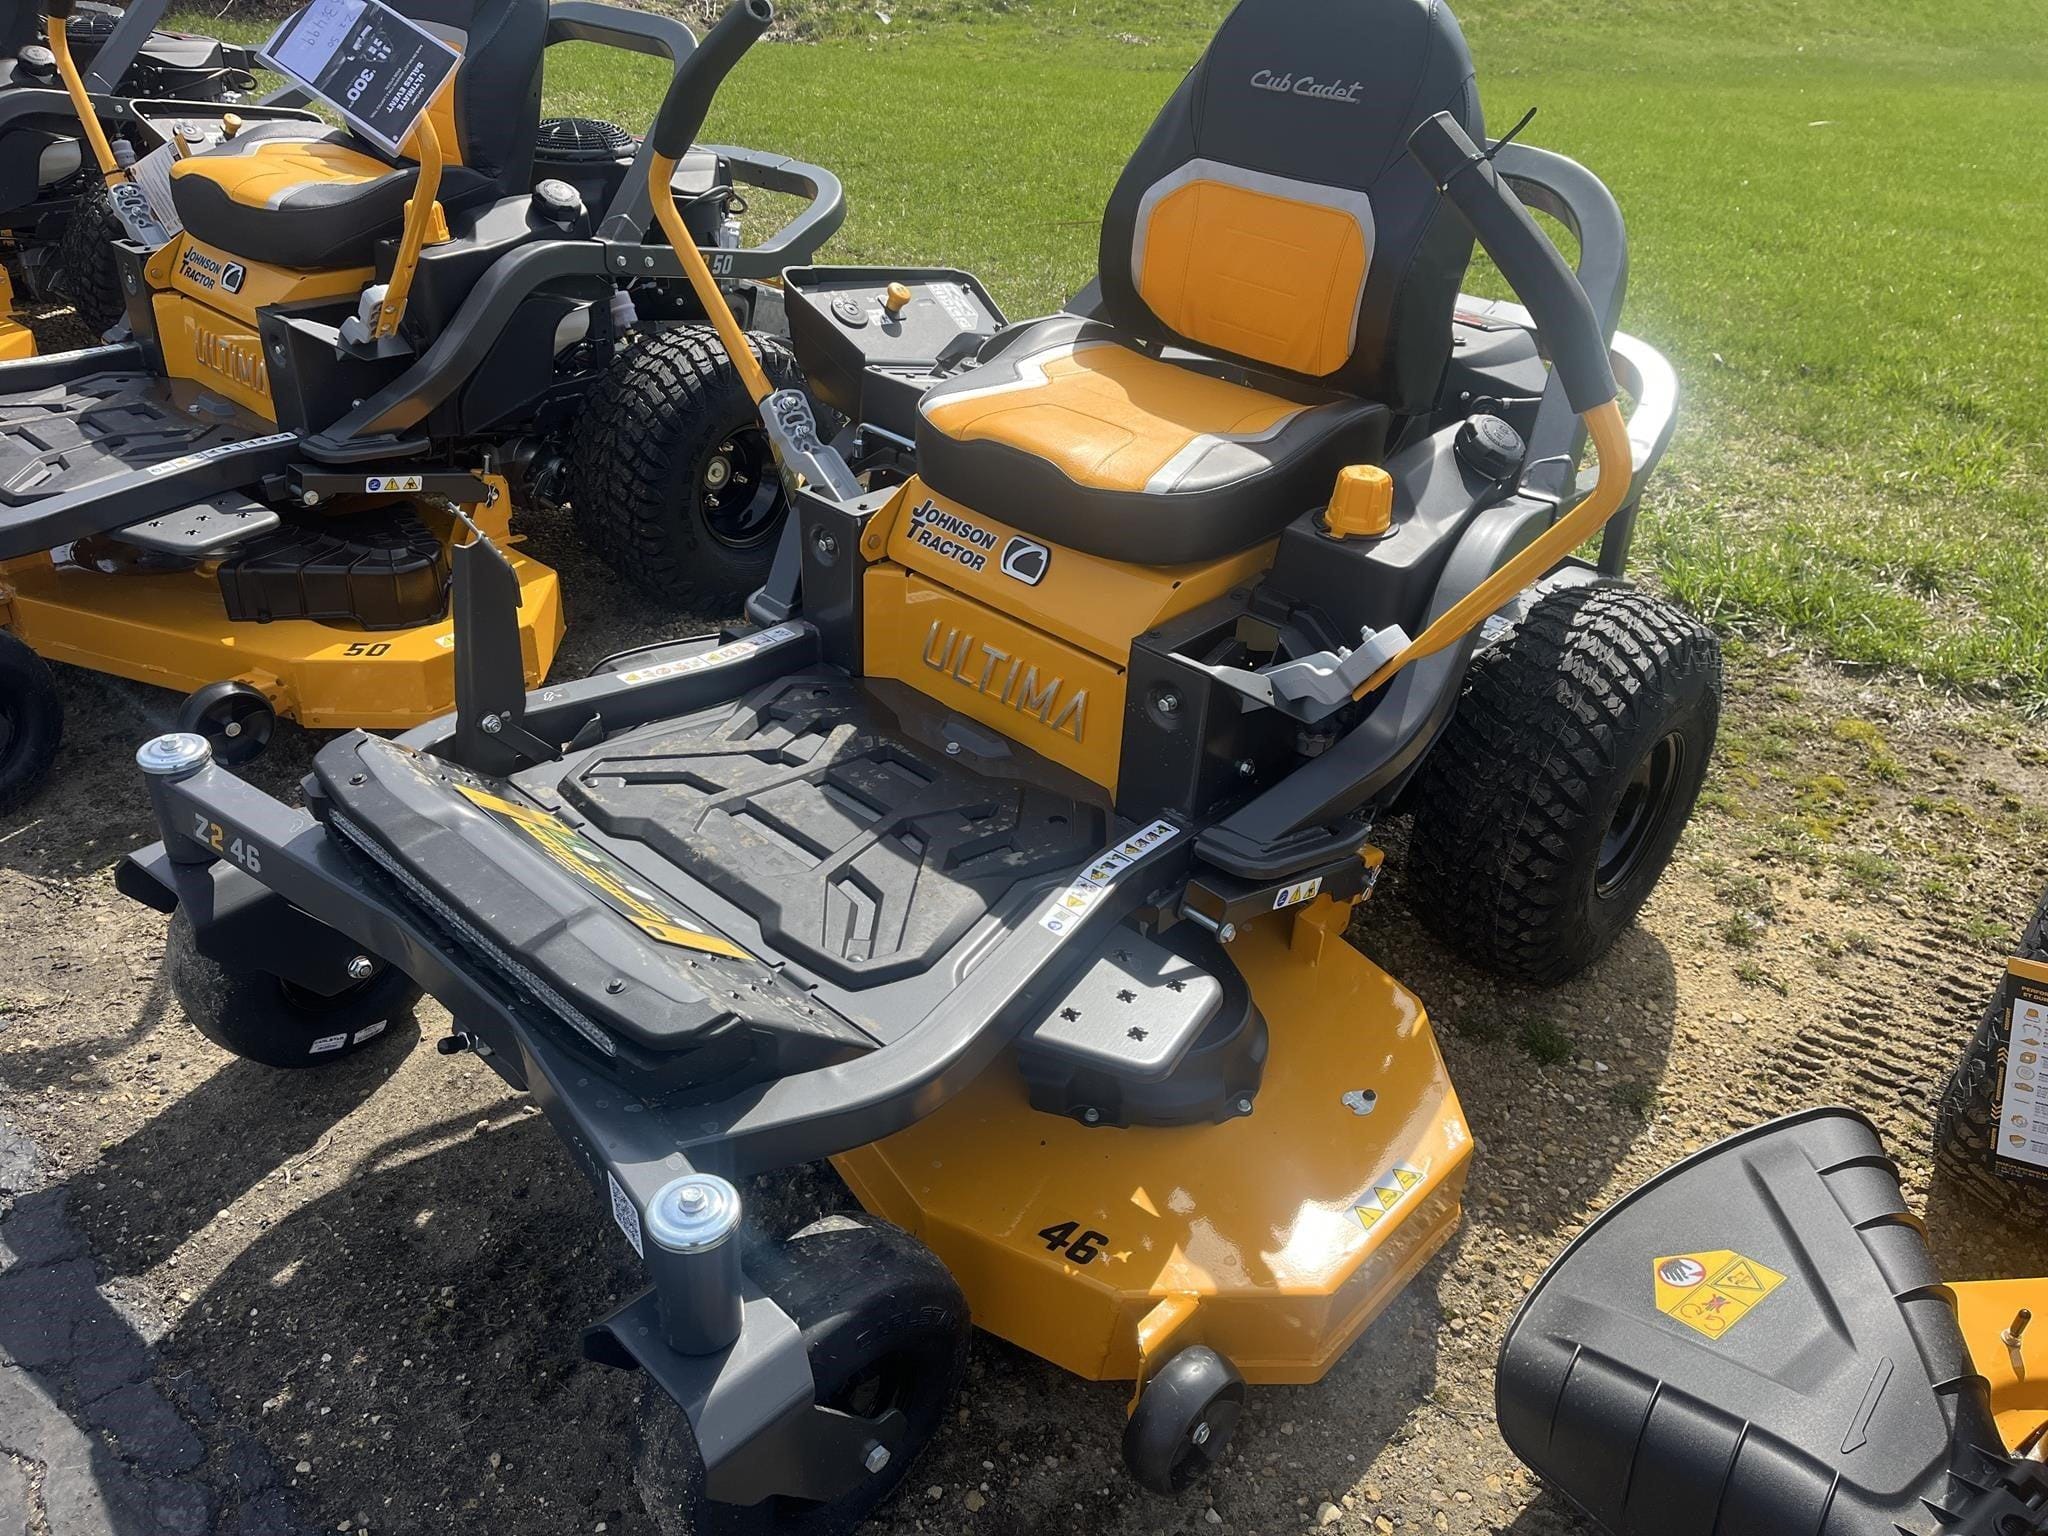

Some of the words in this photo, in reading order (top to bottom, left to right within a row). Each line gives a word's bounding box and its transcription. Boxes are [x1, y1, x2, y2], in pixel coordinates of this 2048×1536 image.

[402, 60, 424, 87] SALES
[1250, 69, 1292, 92] Cub
[1293, 76, 1364, 104] Cadet
[384, 86, 406, 113] EVENT
[395, 72, 426, 111] ULTIMATE
[179, 260, 215, 290] TRACTOR
[184, 246, 222, 274] JOHNSON
[712, 255, 733, 274] 50
[912, 499, 998, 551] JOHNSON
[906, 518, 988, 572] TRACTOR
[343, 642, 391, 656] 50
[923, 619, 1089, 744] ULTIMA
[193, 812, 224, 852] Z2
[229, 837, 261, 874] 46
[1038, 1221, 1109, 1264] 46
